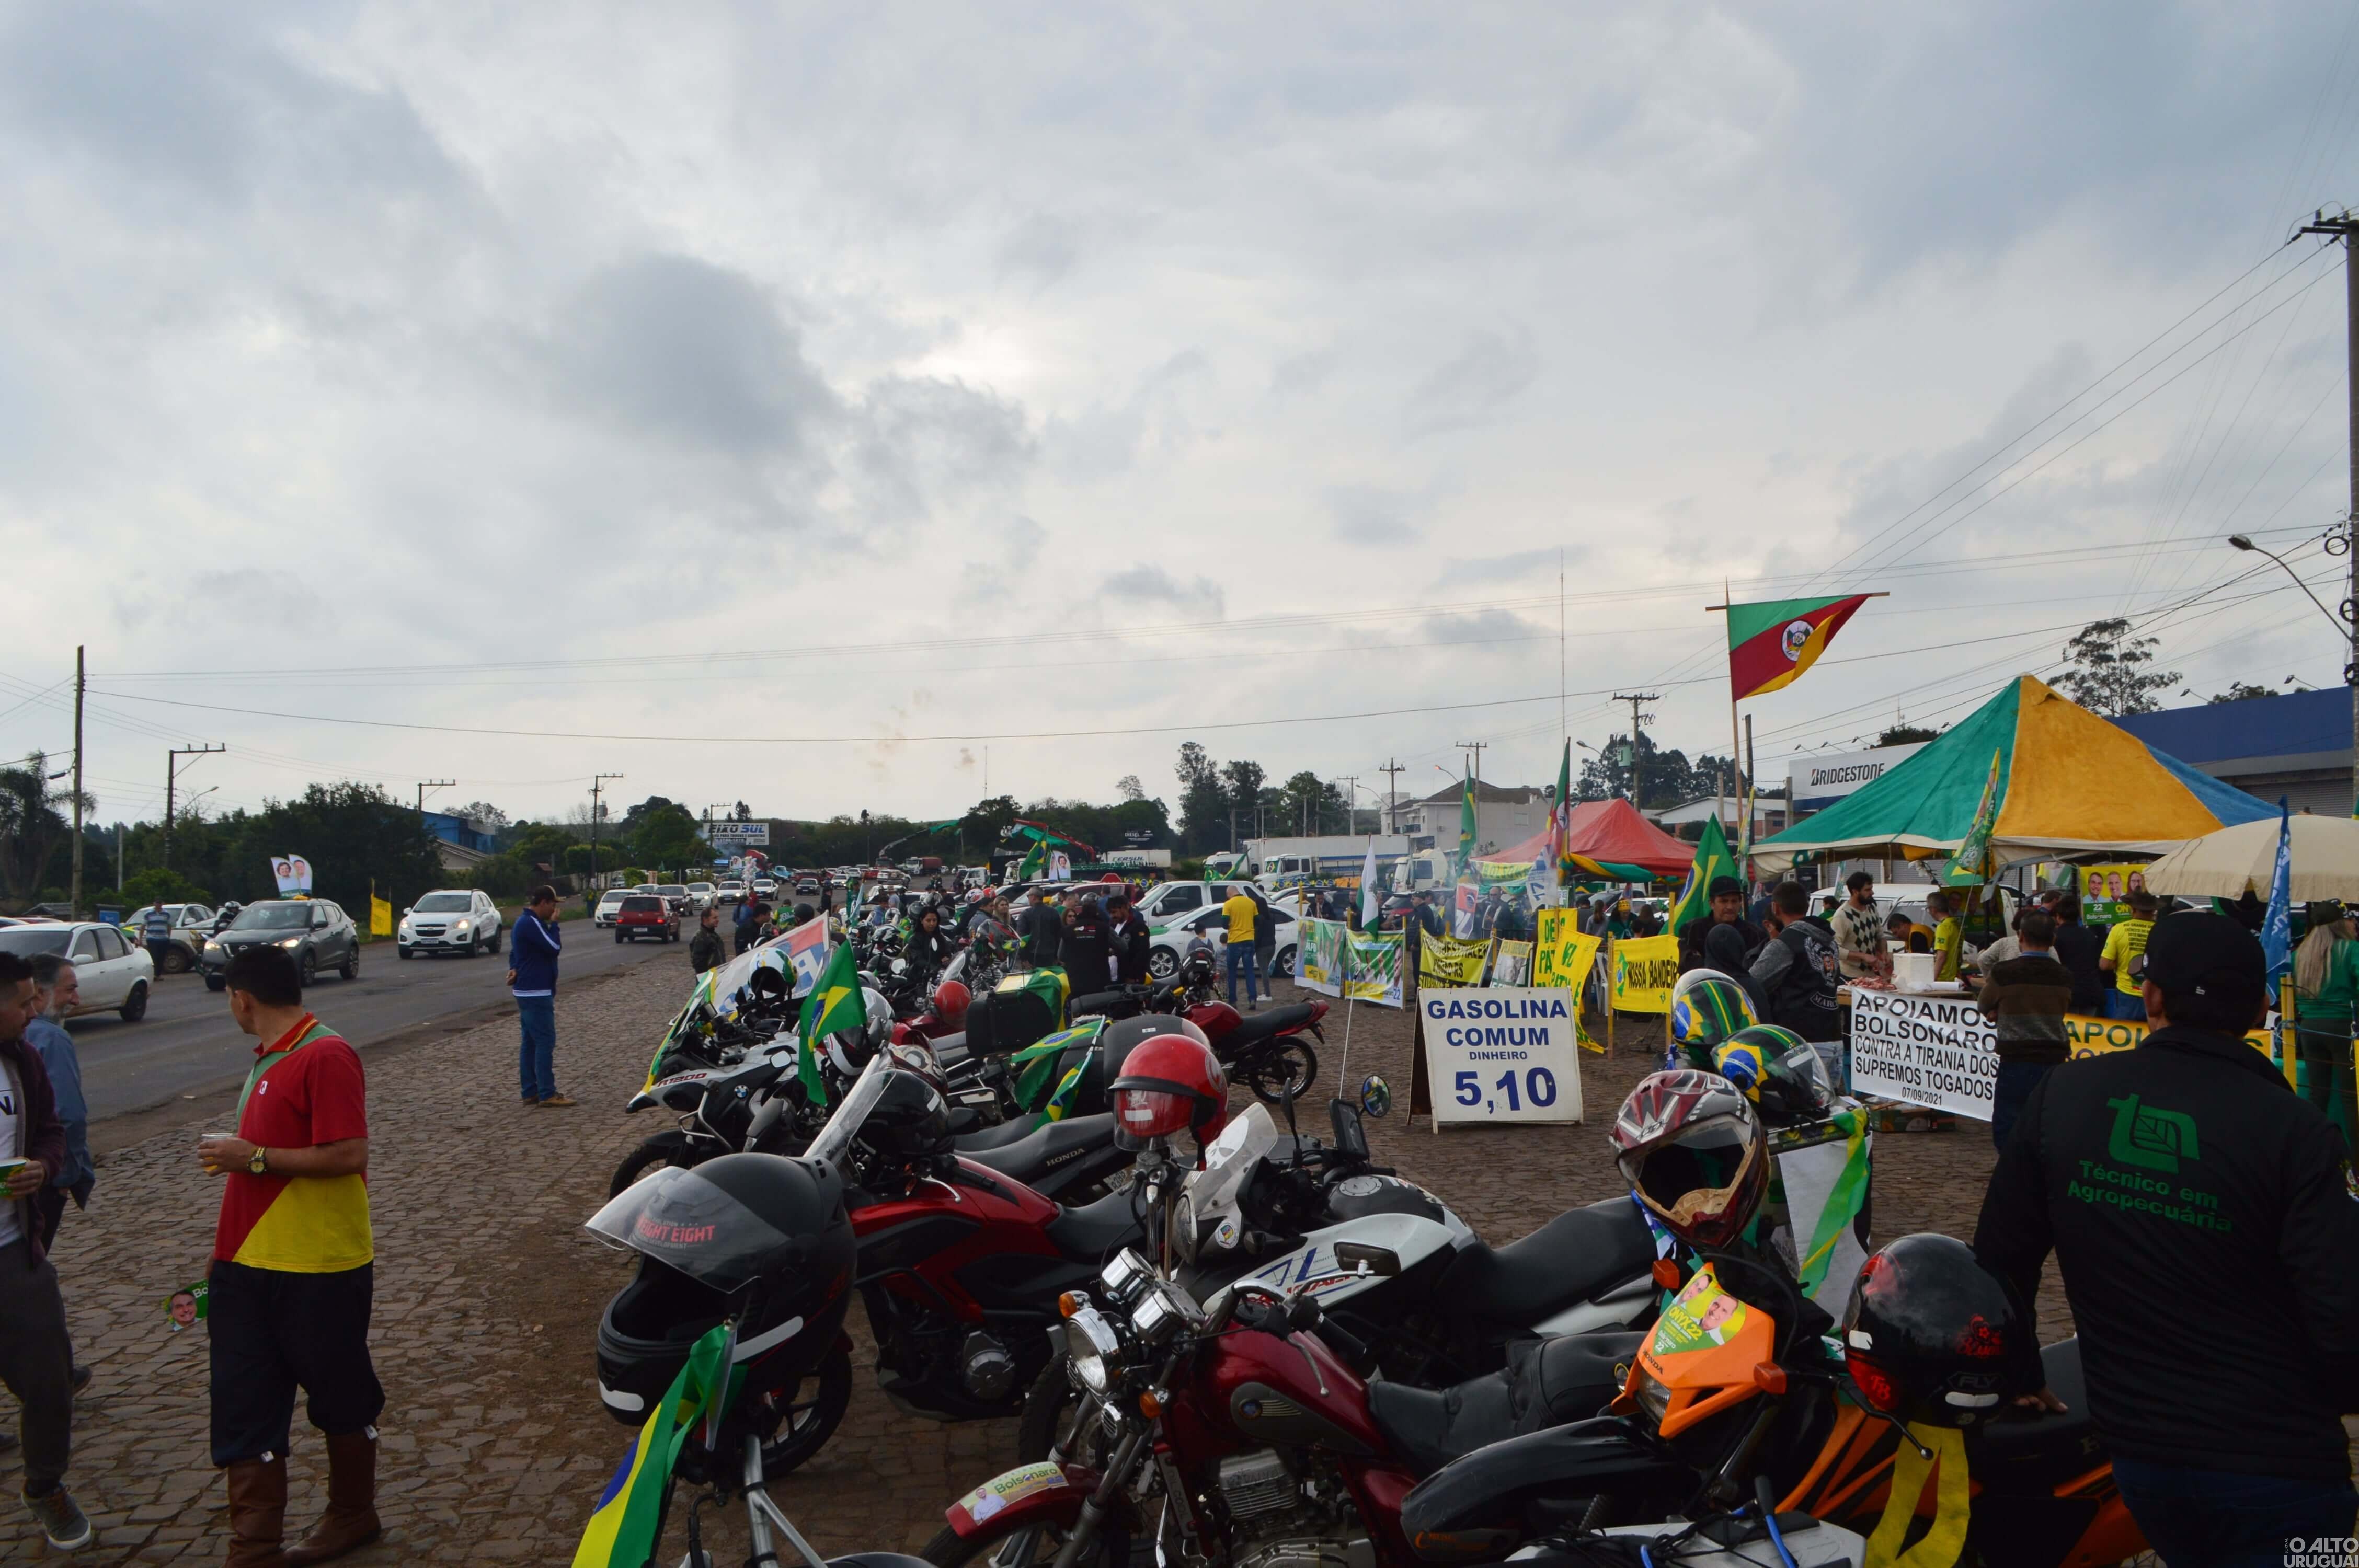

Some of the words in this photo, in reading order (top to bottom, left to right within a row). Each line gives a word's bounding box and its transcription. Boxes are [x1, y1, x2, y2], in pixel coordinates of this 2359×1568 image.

[1811, 763, 1885, 787] BRIDGESTONE
[740, 824, 765, 833] SUL
[1393, 988, 1401, 1000] 22
[1427, 1000, 1568, 1019] GASOLINA
[1446, 1027, 1549, 1046] COMUM
[1855, 1014, 1997, 1054] BOLSONARO
[2065, 1020, 2143, 1048] APOI
[1469, 1051, 1528, 1060] DINHEIRO
[1856, 1035, 1901, 1061] CONTRA
[1904, 1044, 1912, 1063] A
[1916, 1045, 1966, 1073] TIRANIA
[1970, 1055, 1999, 1078] DOS
[1856, 1056, 1921, 1086] SUPREMOS
[1926, 1070, 1993, 1101] TOGADOS
[1455, 1067, 1556, 1114] 5,10
[1902, 1087, 1942, 1106] 07/09/2021
[1046, 1148, 1086, 1166] HONDA
[2079, 1160, 2170, 1196] Técnico
[2180, 1188, 2218, 1209] em
[2067, 1180, 2232, 1233] Agropecuária
[671, 1225, 715, 1242] EIGHT
